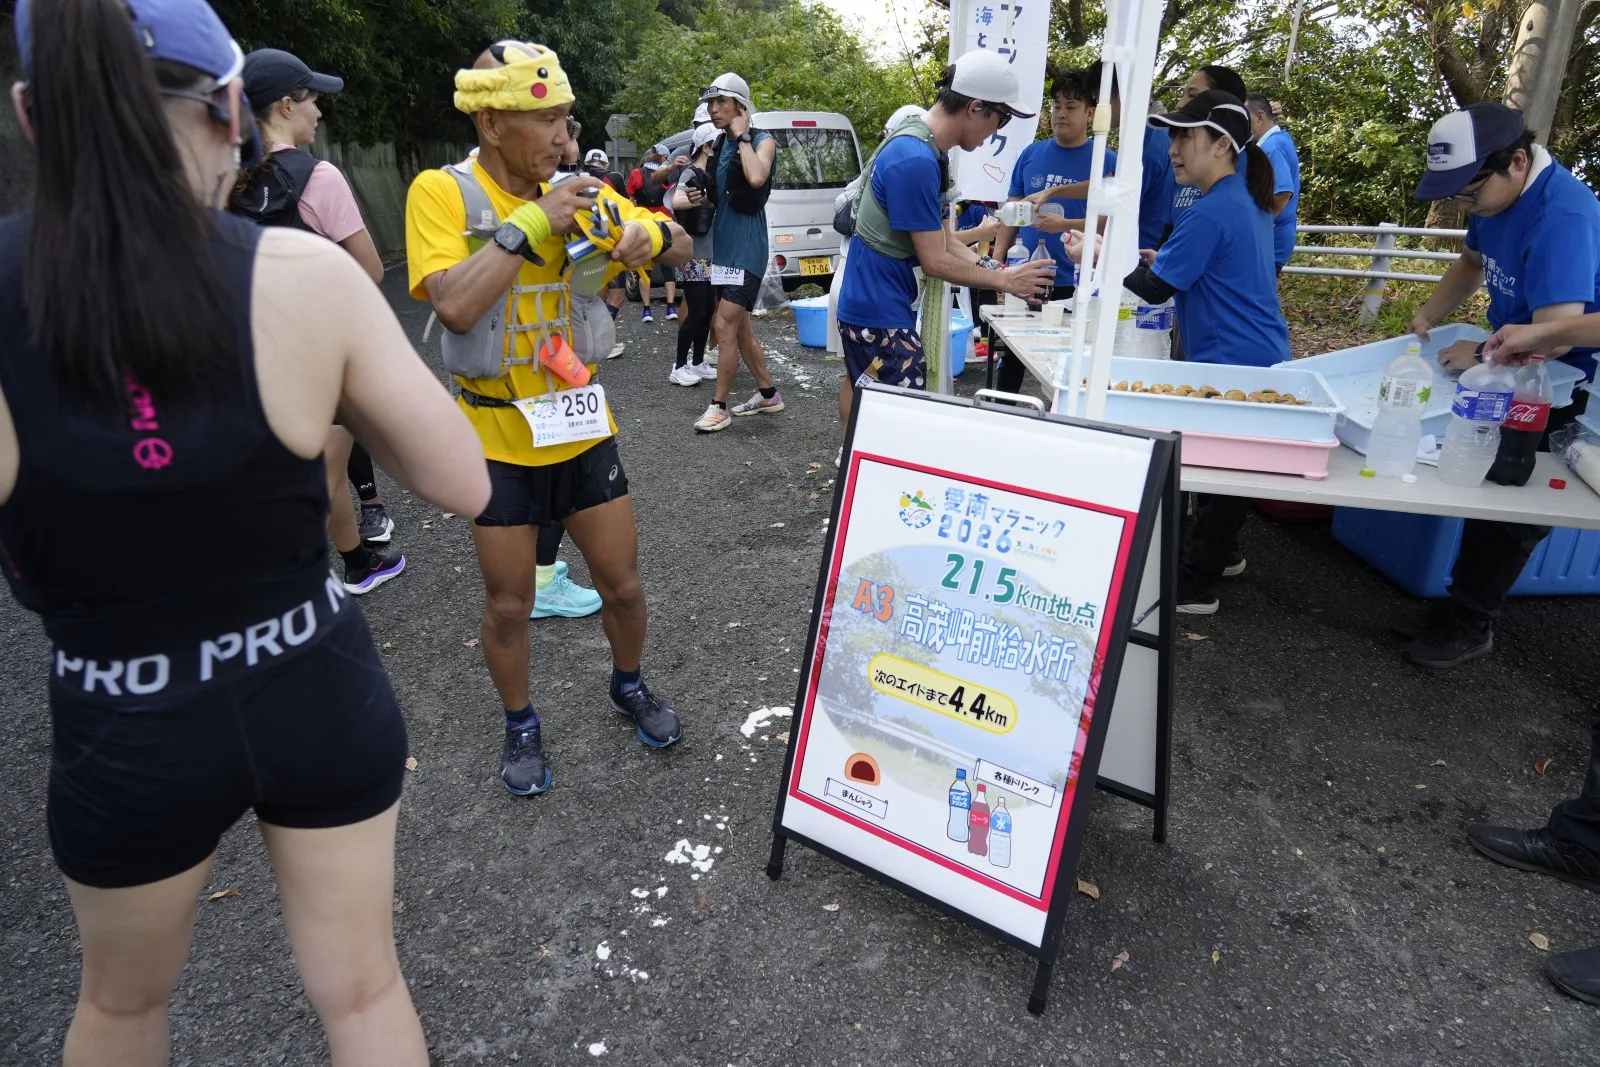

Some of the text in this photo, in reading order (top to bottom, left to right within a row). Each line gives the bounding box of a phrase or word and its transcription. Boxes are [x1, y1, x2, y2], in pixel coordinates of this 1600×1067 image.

[561, 392, 599, 417] 250
[944, 487, 1066, 539] 愛南マラニック
[937, 513, 1012, 554] 2026
[850, 577, 895, 623] A3
[56, 600, 318, 696] PRO PRO
[900, 594, 1077, 682] 高茂岬前給水所
[842, 789, 873, 809] まんじゅう
[994, 771, 1040, 796] 各種ドリンク
[971, 814, 988, 824] コーラ
[996, 818, 1006, 830] 水
